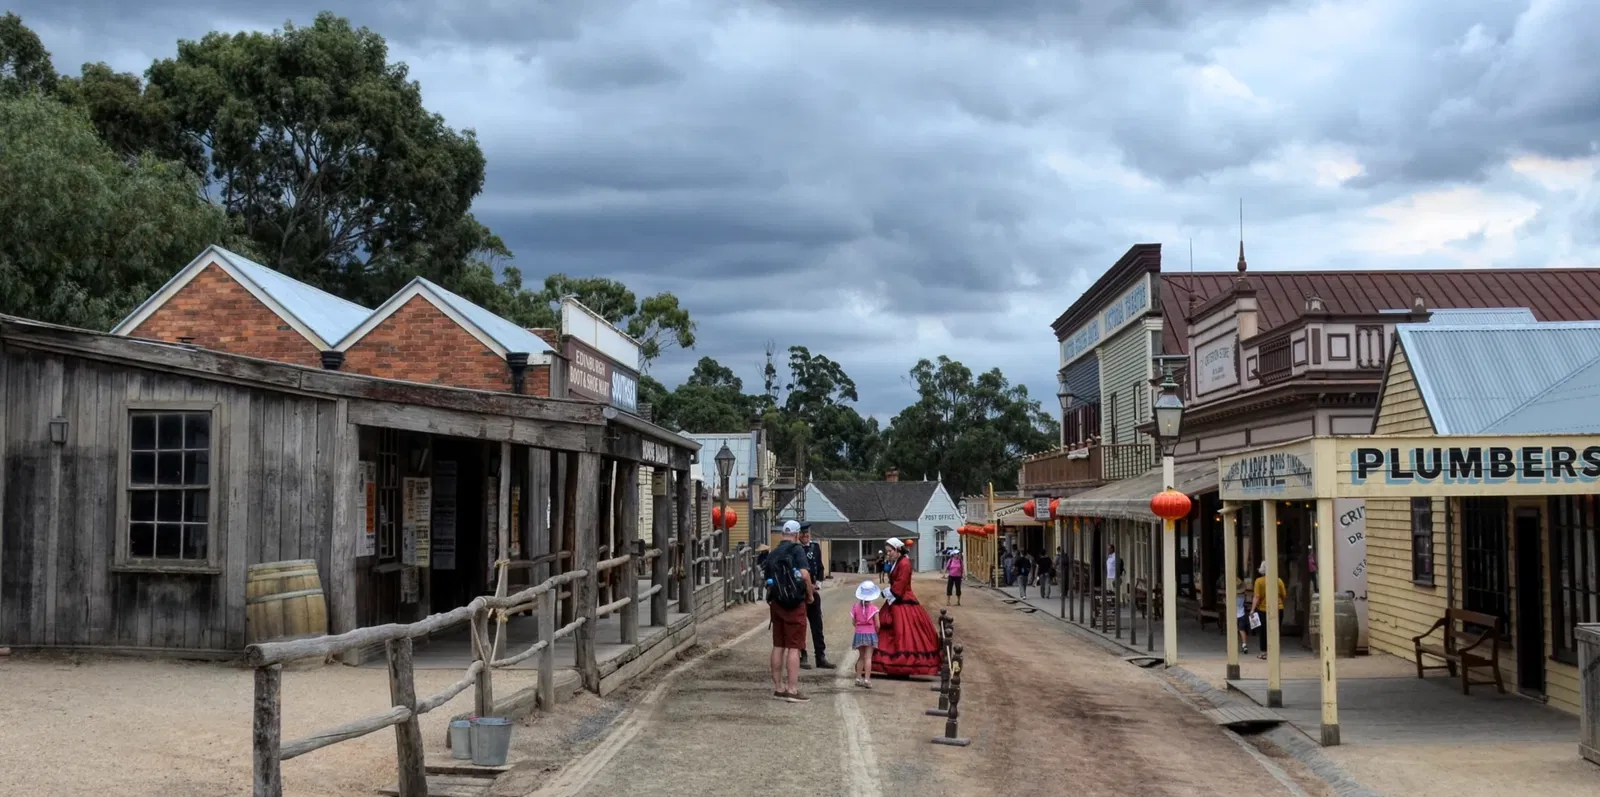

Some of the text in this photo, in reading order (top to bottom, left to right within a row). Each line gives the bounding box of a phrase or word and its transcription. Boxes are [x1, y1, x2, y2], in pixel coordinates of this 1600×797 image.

[575, 350, 605, 377] EDINBURGH
[570, 366, 583, 387] BOOT
[587, 373, 598, 393] SHOE
[1241, 455, 1267, 488] CLARKE
[1355, 446, 1600, 483] PLUMBERS
